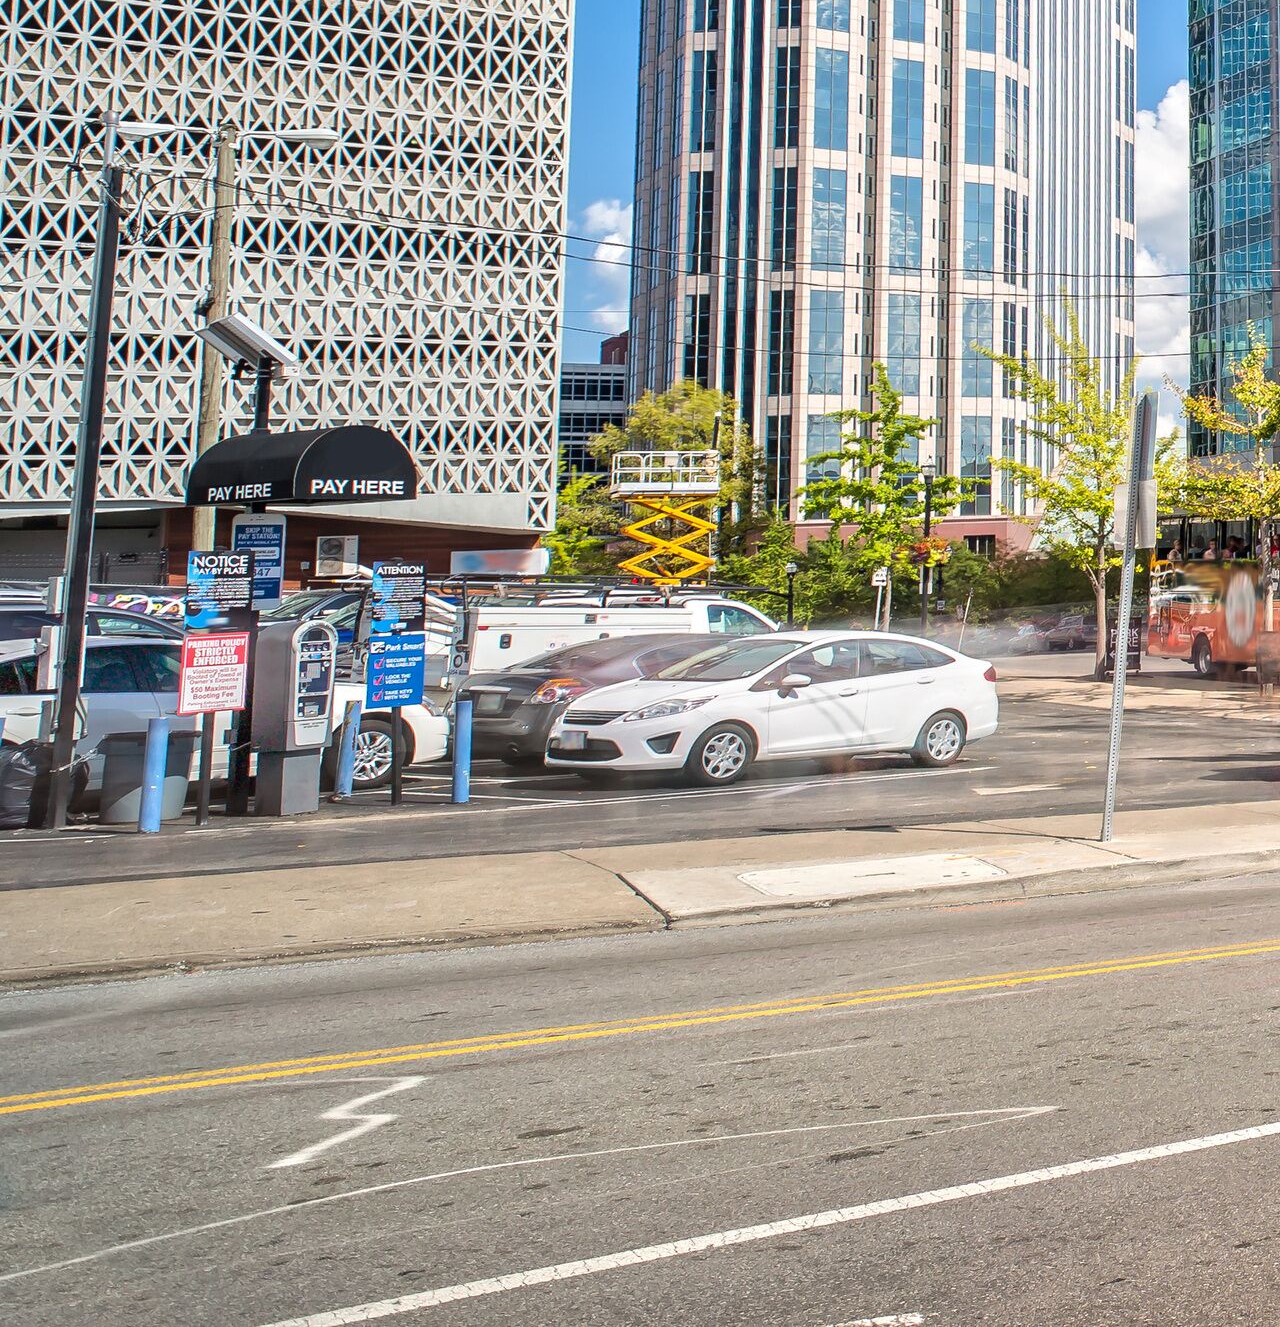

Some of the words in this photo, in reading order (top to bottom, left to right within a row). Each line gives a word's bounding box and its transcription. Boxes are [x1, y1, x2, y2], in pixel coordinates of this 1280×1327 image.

[208, 486, 233, 502] PAY
[235, 482, 272, 500] HERE
[313, 479, 348, 494] PAY
[352, 480, 404, 495] HERE
[193, 555, 249, 568] NOTICE
[223, 566, 248, 574] PLATE
[377, 565, 424, 575] ATTENTION
[1110, 628, 1139, 637] PRK
[188, 640, 220, 648] PARKING
[221, 638, 246, 646] POLICY
[1110, 637, 1139, 648] HRE
[194, 647, 236, 657] STRICTLY
[193, 655, 238, 666] ENFORCED
